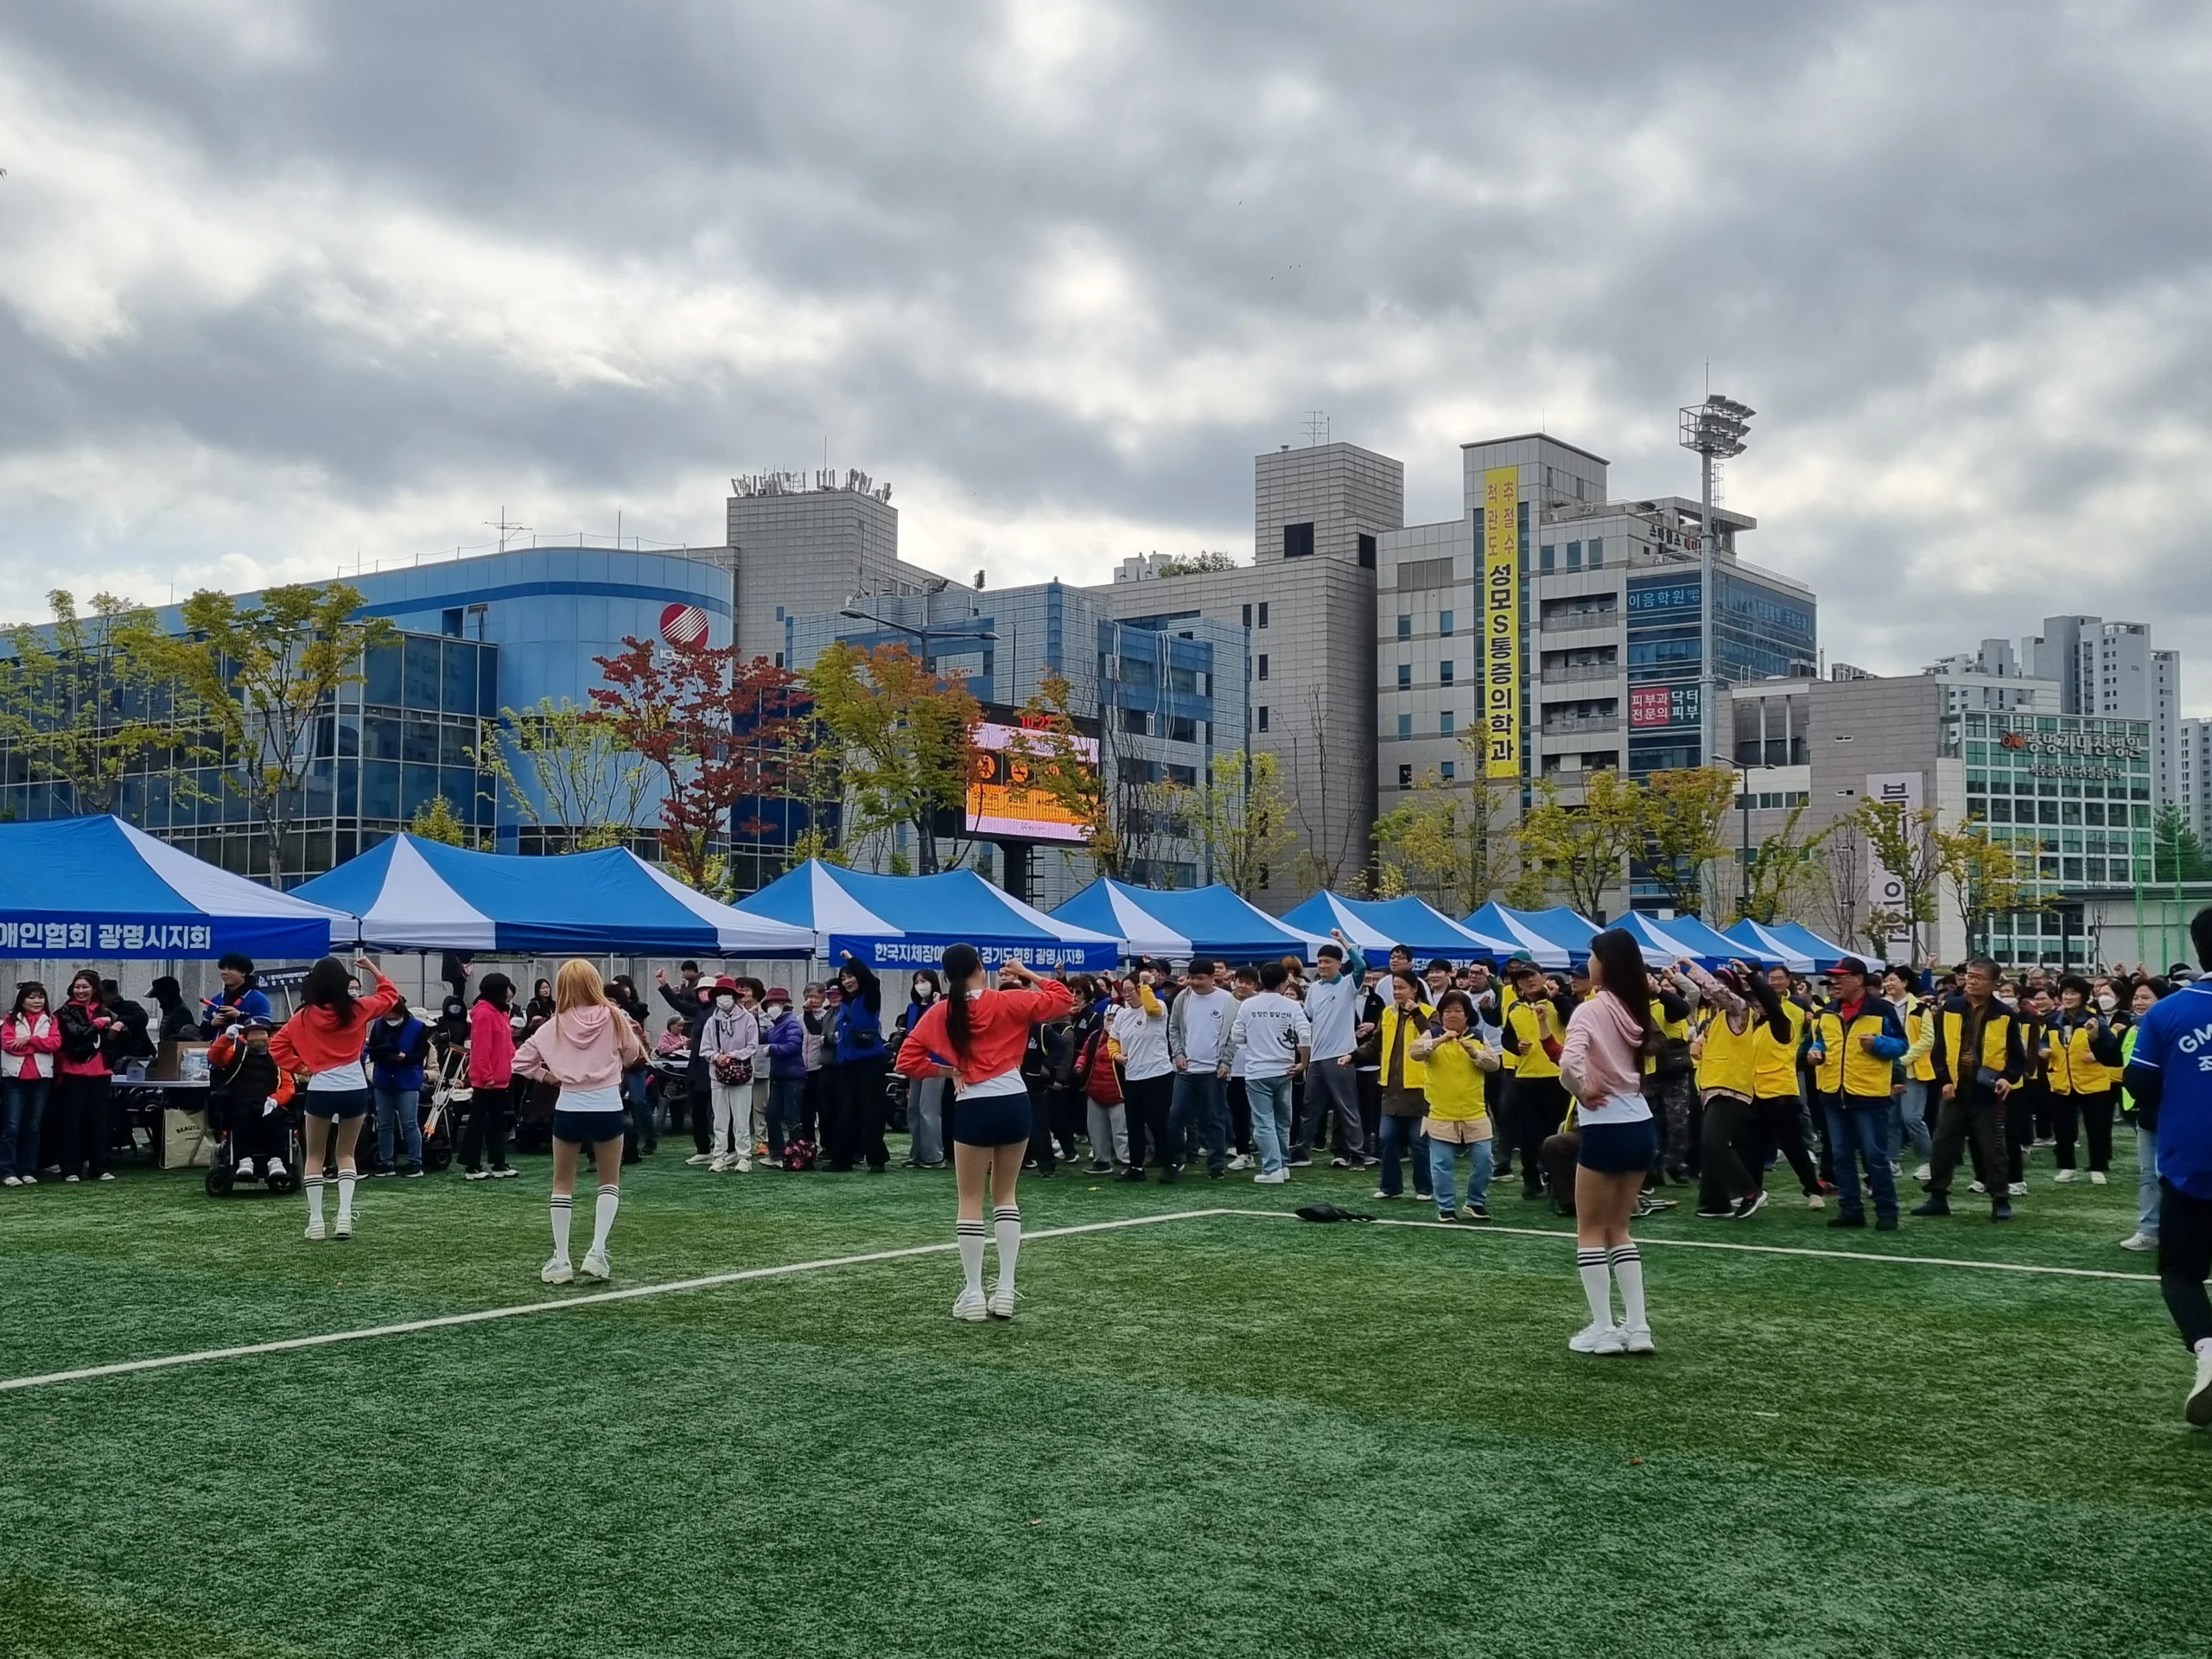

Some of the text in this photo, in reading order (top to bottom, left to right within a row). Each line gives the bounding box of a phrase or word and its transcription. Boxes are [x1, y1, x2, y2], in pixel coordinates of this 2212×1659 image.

[1487, 480, 1515, 504] 척추
[1488, 507, 1515, 531] 관절
[1488, 533, 1515, 556] 도수
[1628, 588, 1685, 609] 이음학원
[1489, 563, 1515, 761] 성모S통증의학과
[1631, 692, 1669, 707] 피부과
[1671, 690, 1699, 705] 닥터
[1631, 707, 1669, 721] 전문의
[1671, 704, 1700, 720] 피부
[98, 924, 211, 950] 광명시지회
[874, 942, 978, 963] 한국지체장애
[1035, 948, 1085, 964] 광명시지회
